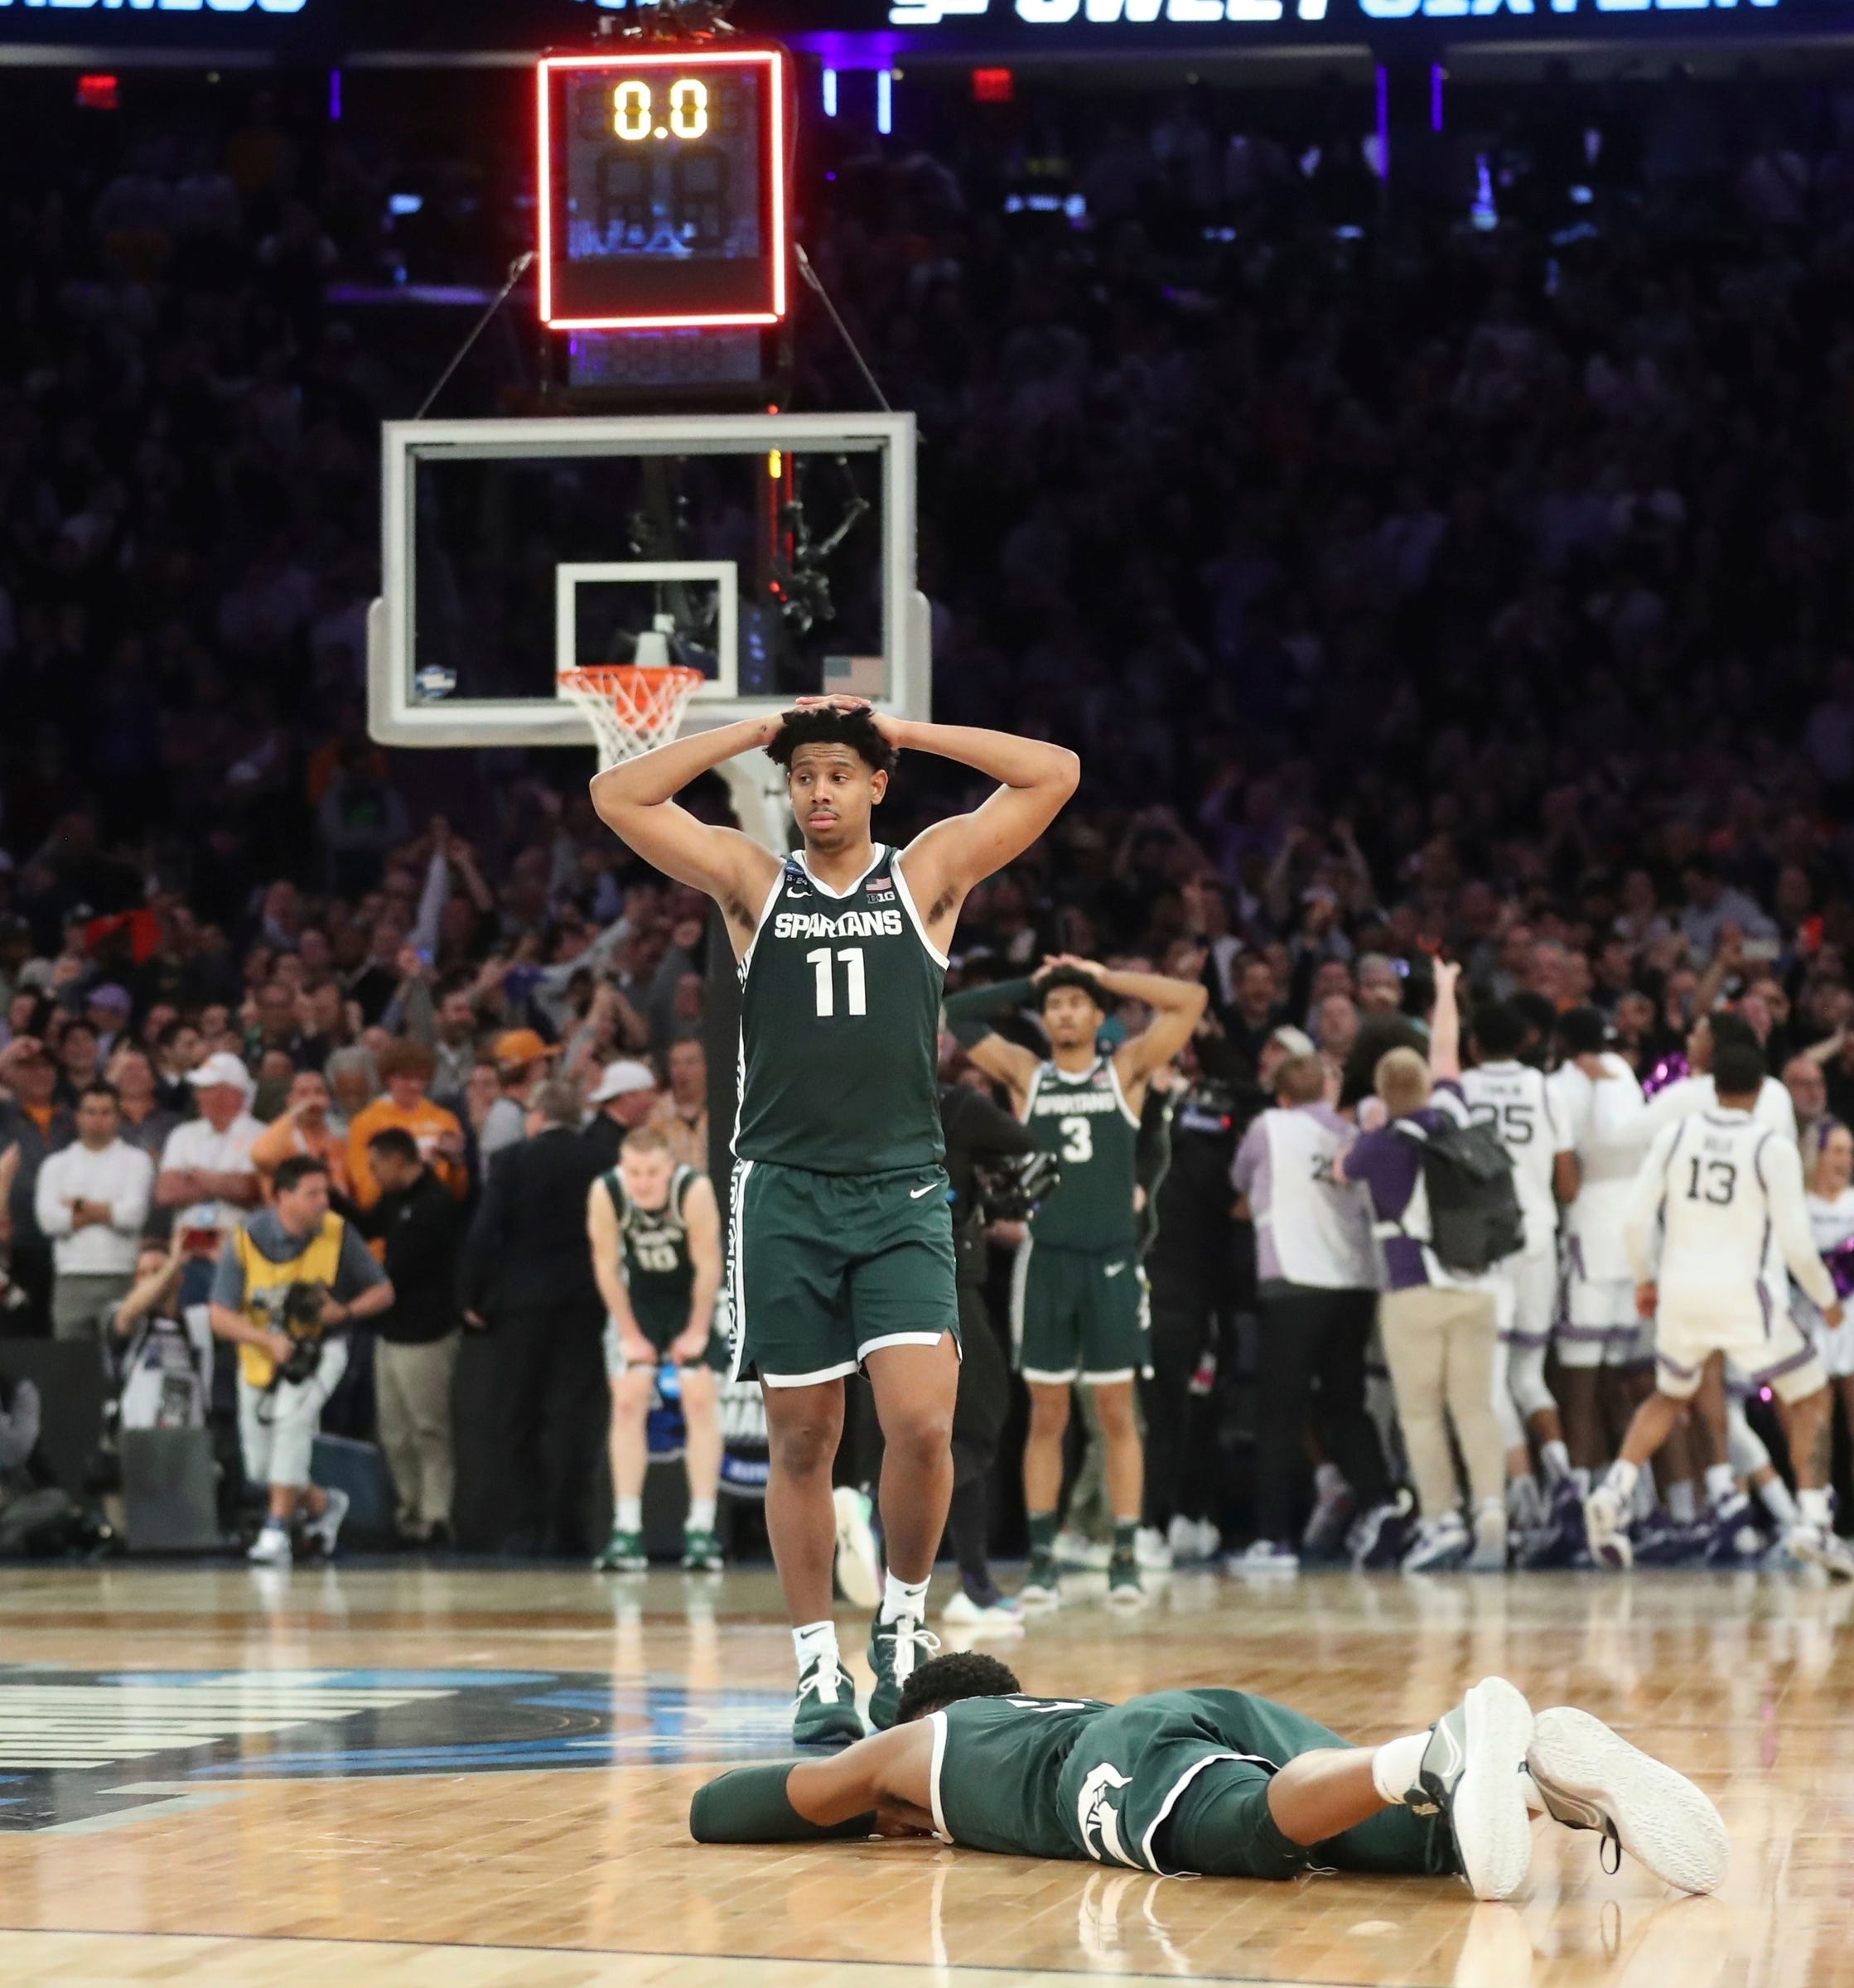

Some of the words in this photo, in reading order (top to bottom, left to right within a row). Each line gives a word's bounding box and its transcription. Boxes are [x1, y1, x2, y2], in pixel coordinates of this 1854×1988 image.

[614, 80, 707, 140] 0.0
[775, 910, 903, 939] SPARTANS
[806, 948, 867, 1017] 11
[1060, 1117, 1094, 1162] 3
[1687, 1156, 1737, 1204] 13
